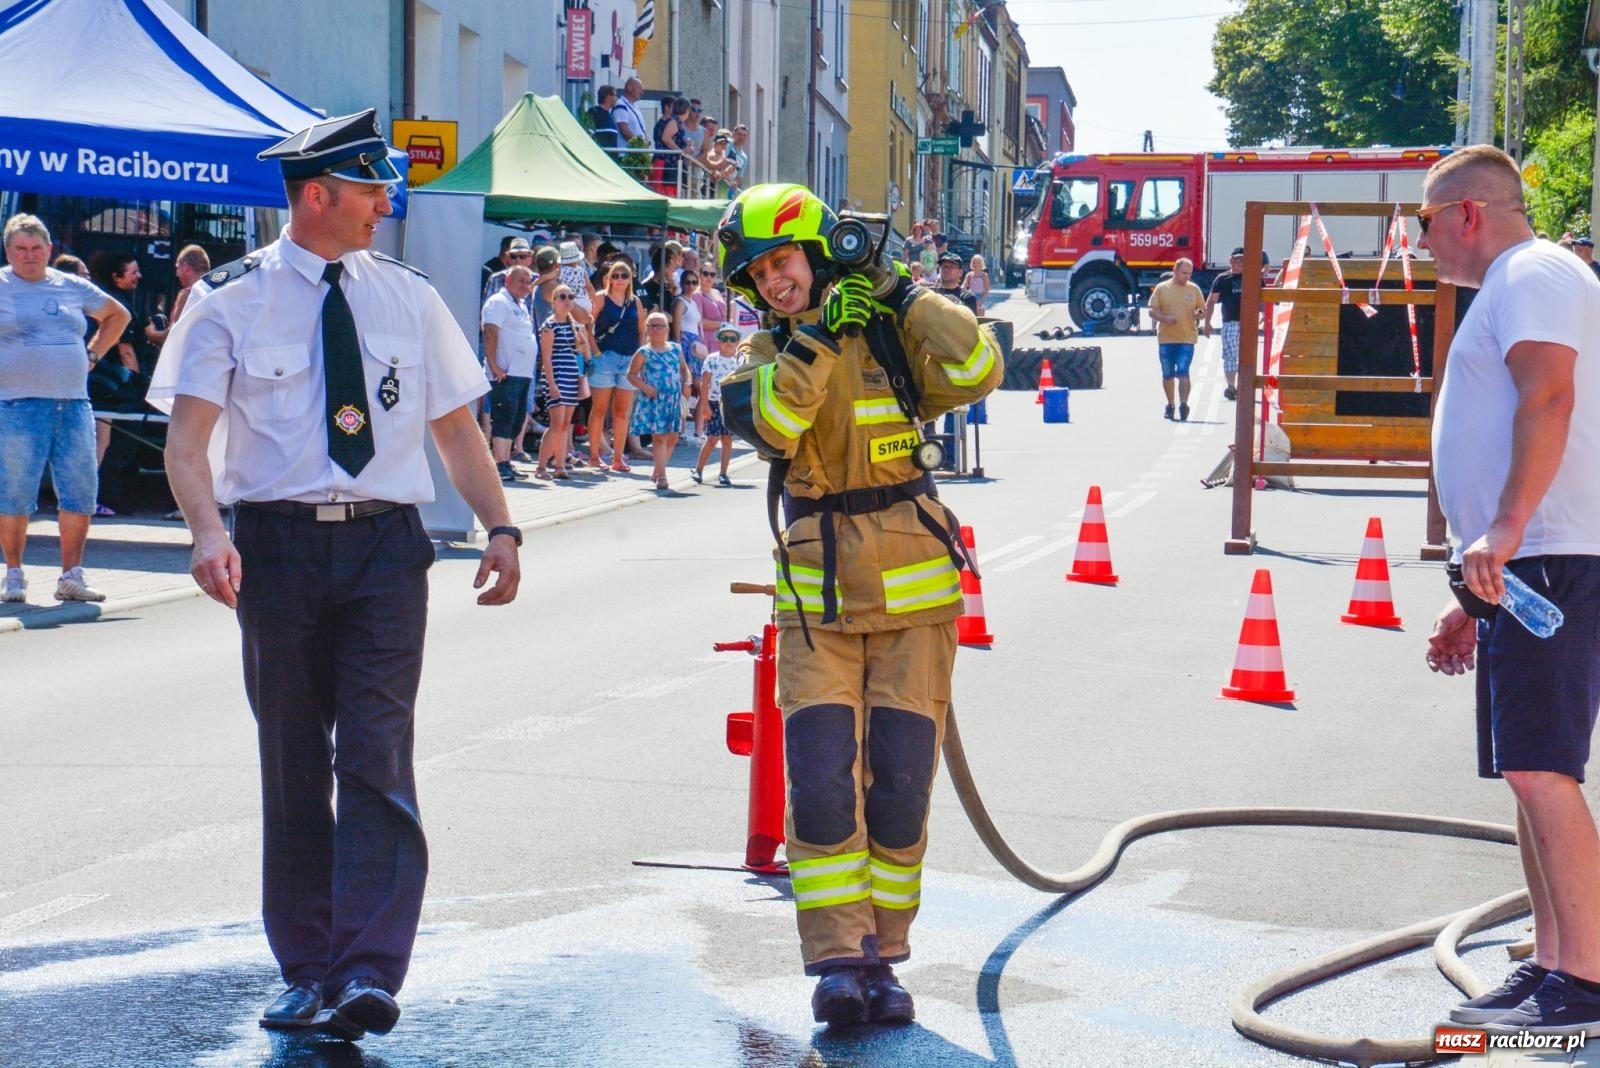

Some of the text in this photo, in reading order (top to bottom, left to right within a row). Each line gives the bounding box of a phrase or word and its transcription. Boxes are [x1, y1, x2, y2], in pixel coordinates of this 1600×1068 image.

[569, 14, 586, 72] ŻYWIEC
[39, 151, 68, 172] w
[77, 148, 229, 184] Raciborzu
[409, 148, 441, 160] STRAŻ
